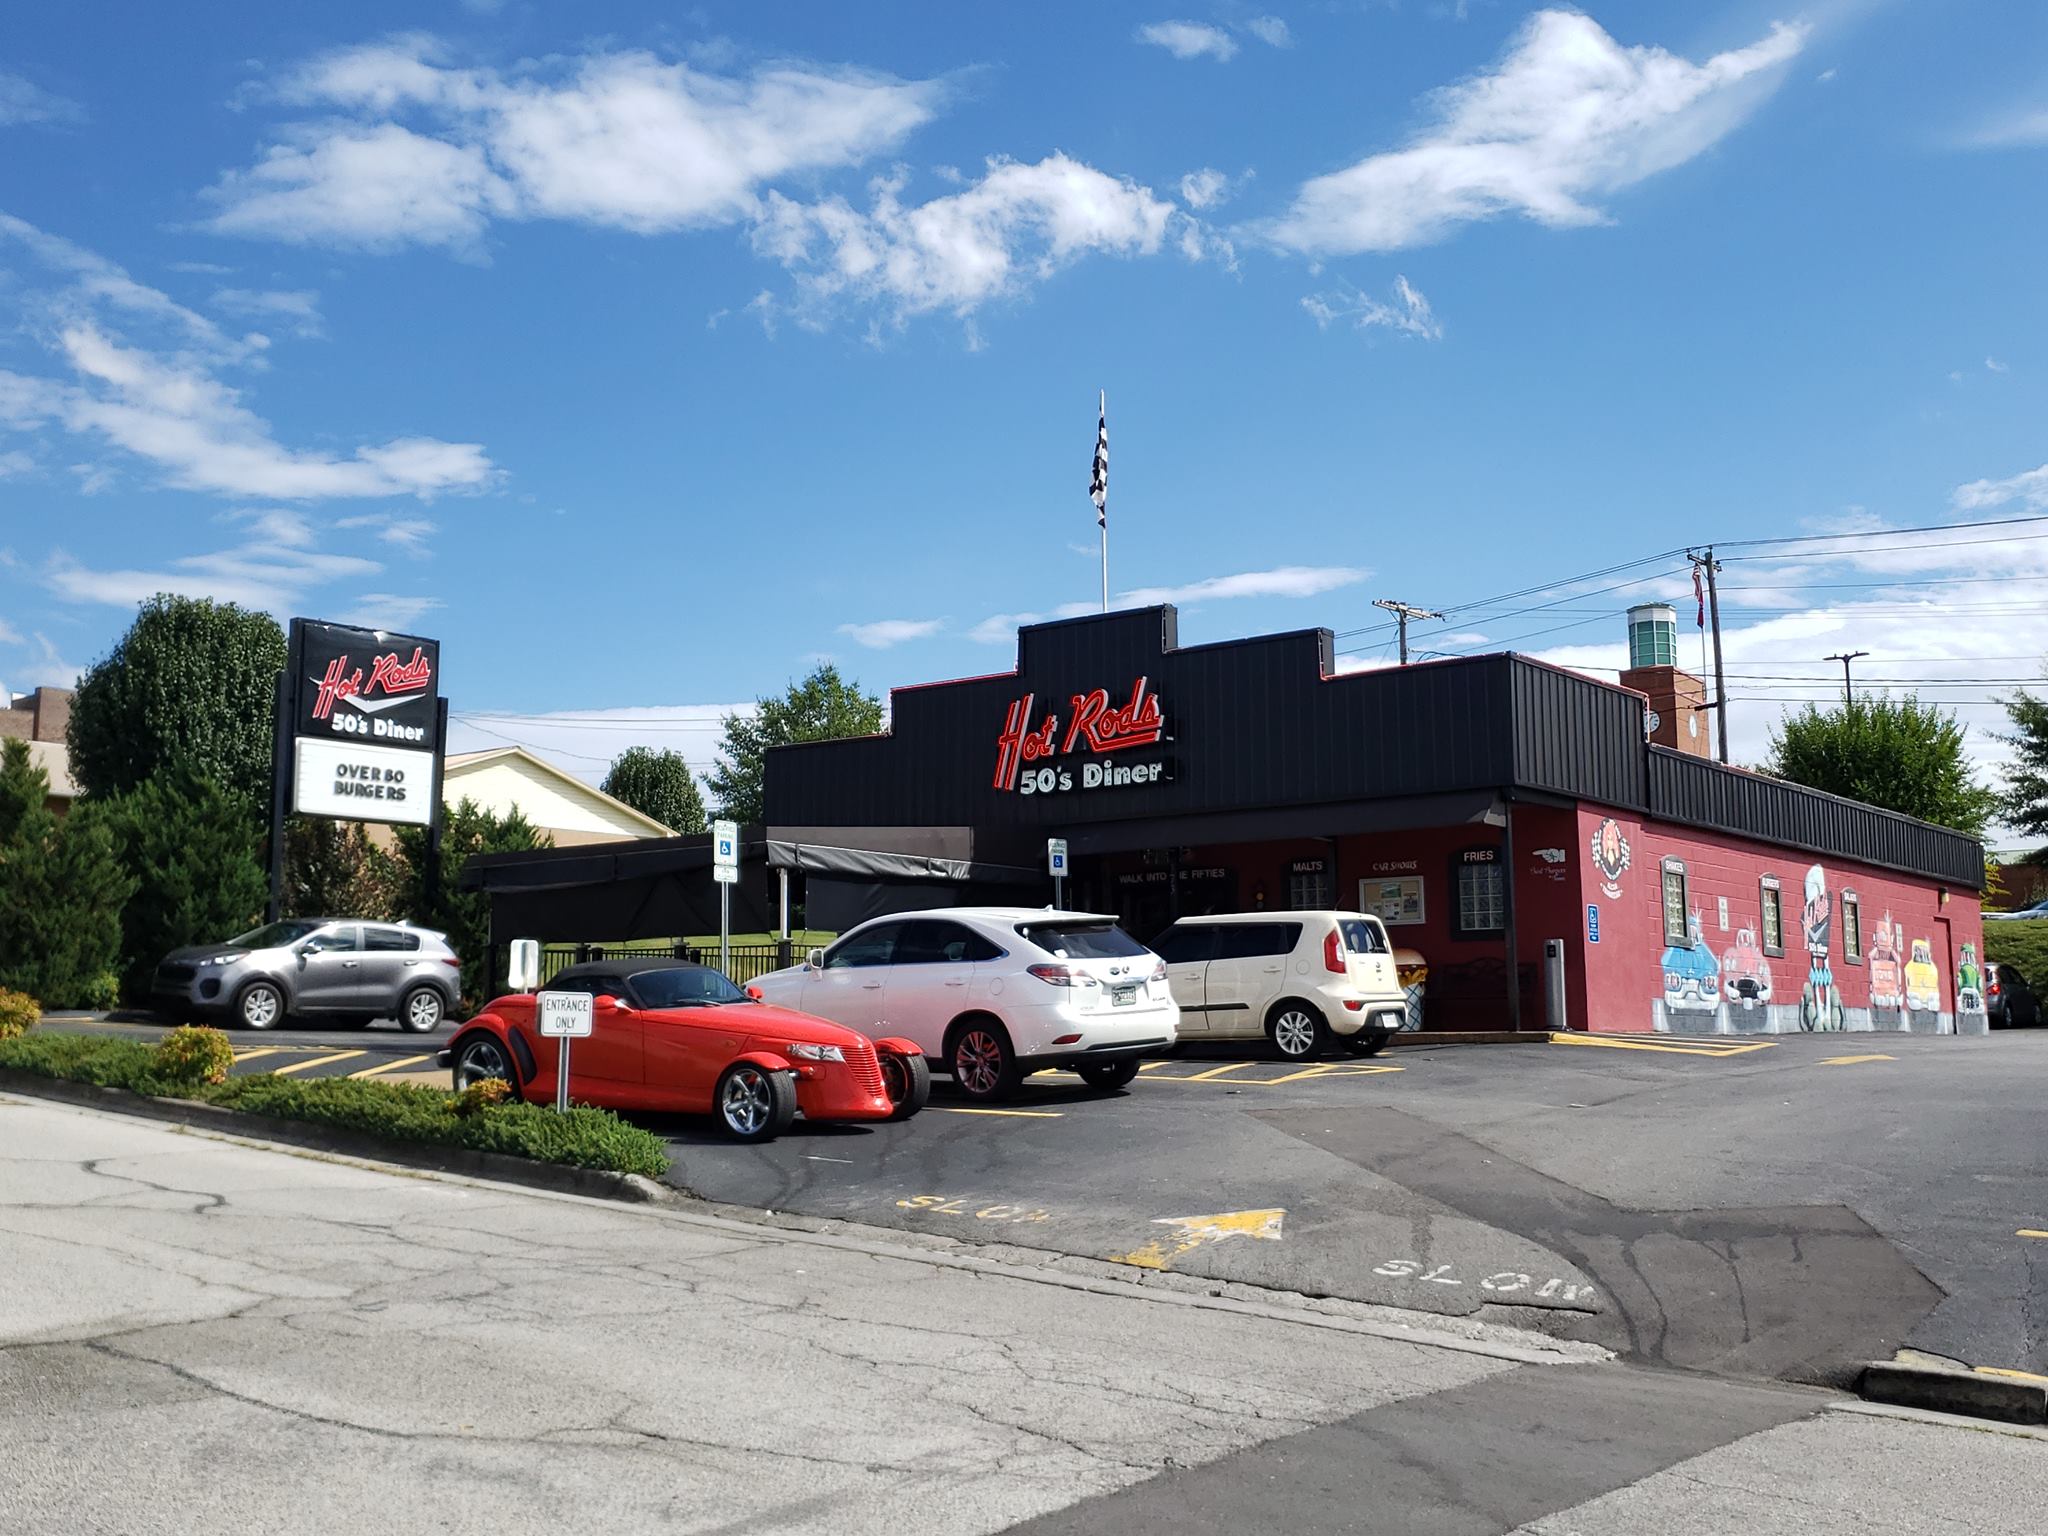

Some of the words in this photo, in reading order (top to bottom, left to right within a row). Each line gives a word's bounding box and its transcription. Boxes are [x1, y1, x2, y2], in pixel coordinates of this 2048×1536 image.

[312, 655, 363, 719] Hot
[364, 647, 431, 694] Rods
[332, 712, 368, 735] 50's
[374, 718, 424, 742] Diner
[993, 693, 1058, 792] Hot
[1062, 676, 1165, 752] Rods
[336, 763, 381, 781] OVER
[1020, 766, 1072, 794] 50's
[1083, 760, 1163, 788] Diner
[334, 781, 407, 801] BURGERS
[1464, 850, 1494, 861] FRIES
[1293, 861, 1323, 872] MALTS
[1119, 873, 1143, 884] WALK
[1146, 872, 1167, 882] INTO
[1190, 868, 1225, 879] FIFTIES
[546, 998, 588, 1012] ENTRANCE
[555, 1016, 576, 1029] ONLY
